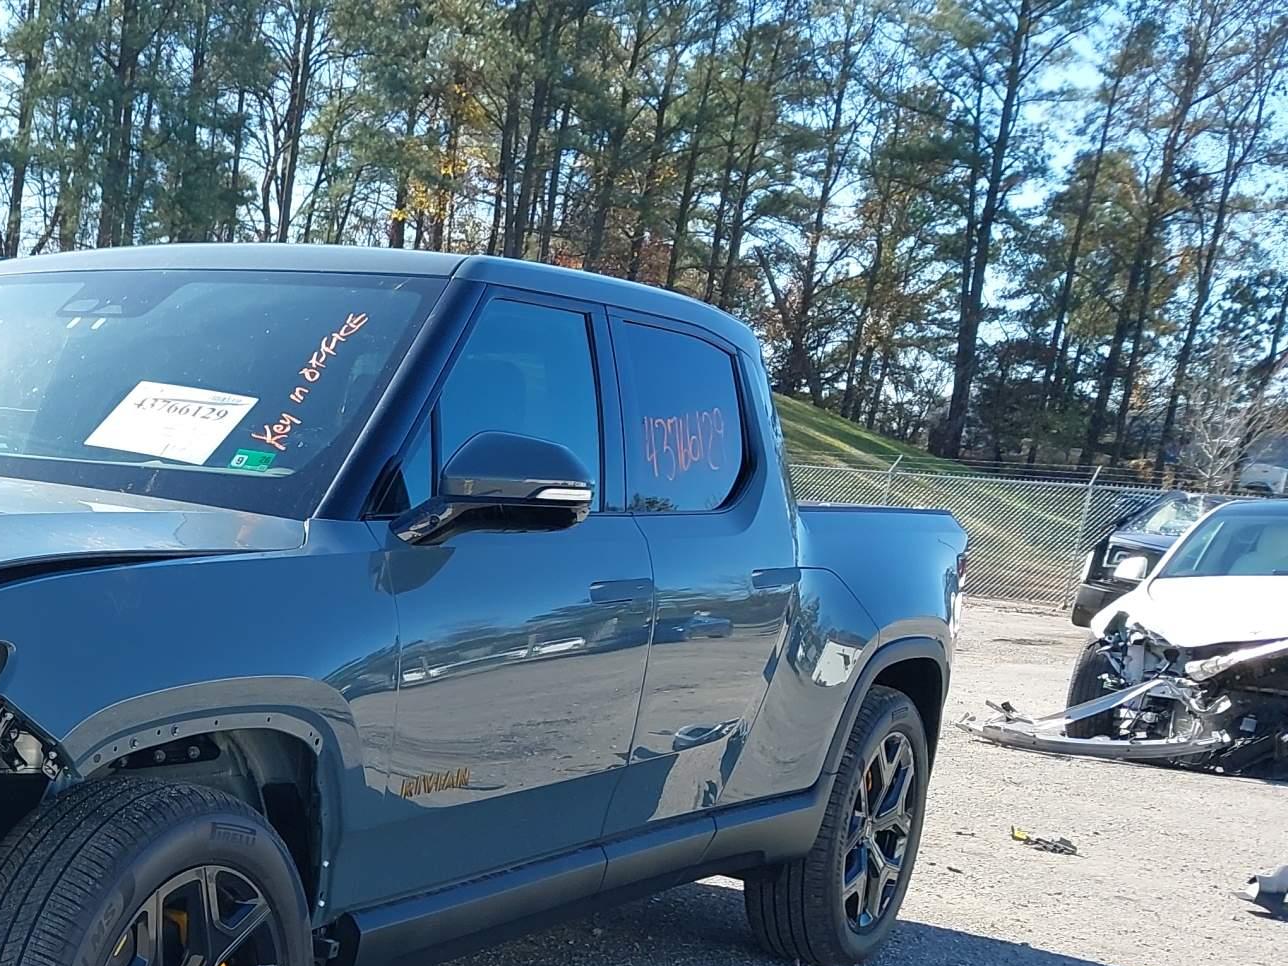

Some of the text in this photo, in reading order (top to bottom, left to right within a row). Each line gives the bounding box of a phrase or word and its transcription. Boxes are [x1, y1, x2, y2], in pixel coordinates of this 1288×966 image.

[134, 397, 229, 421] 43766129
[251, 412, 302, 451] Key
[289, 386, 309, 404] in
